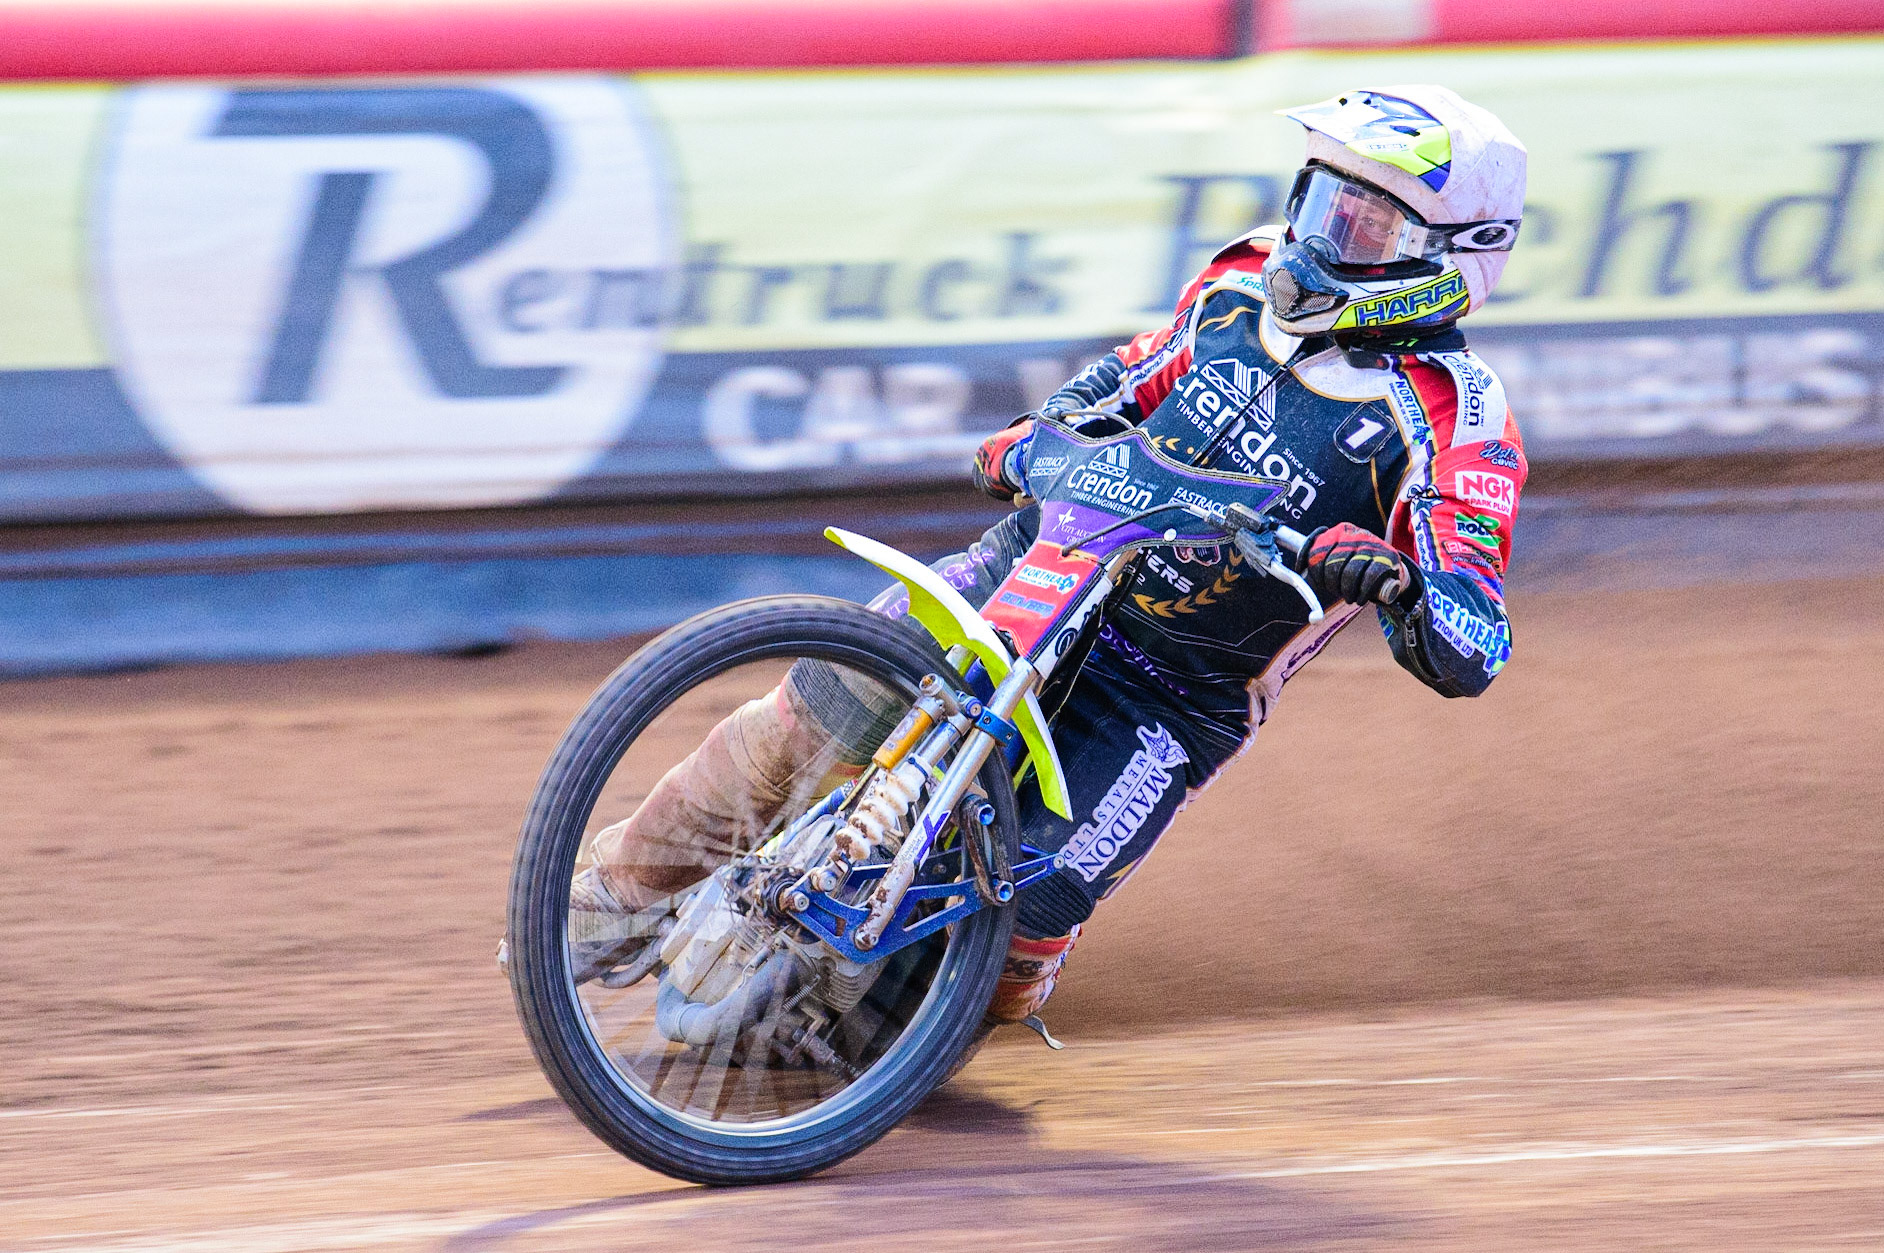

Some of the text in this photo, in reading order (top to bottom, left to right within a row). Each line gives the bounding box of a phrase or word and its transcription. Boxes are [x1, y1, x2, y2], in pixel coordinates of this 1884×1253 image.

[1176, 398, 1214, 438] TIMBER
[1344, 417, 1385, 450] 1
[1283, 447, 1326, 487] Since 1967
[1066, 464, 1153, 511] Crendon
[1173, 486, 1228, 515] FASTRACK
[1462, 474, 1512, 505] NGK
[1453, 634, 1463, 648] UK
[1461, 643, 1473, 656] LTD
[1063, 754, 1148, 860] METALS LTD
[1077, 755, 1171, 877] MALDON
